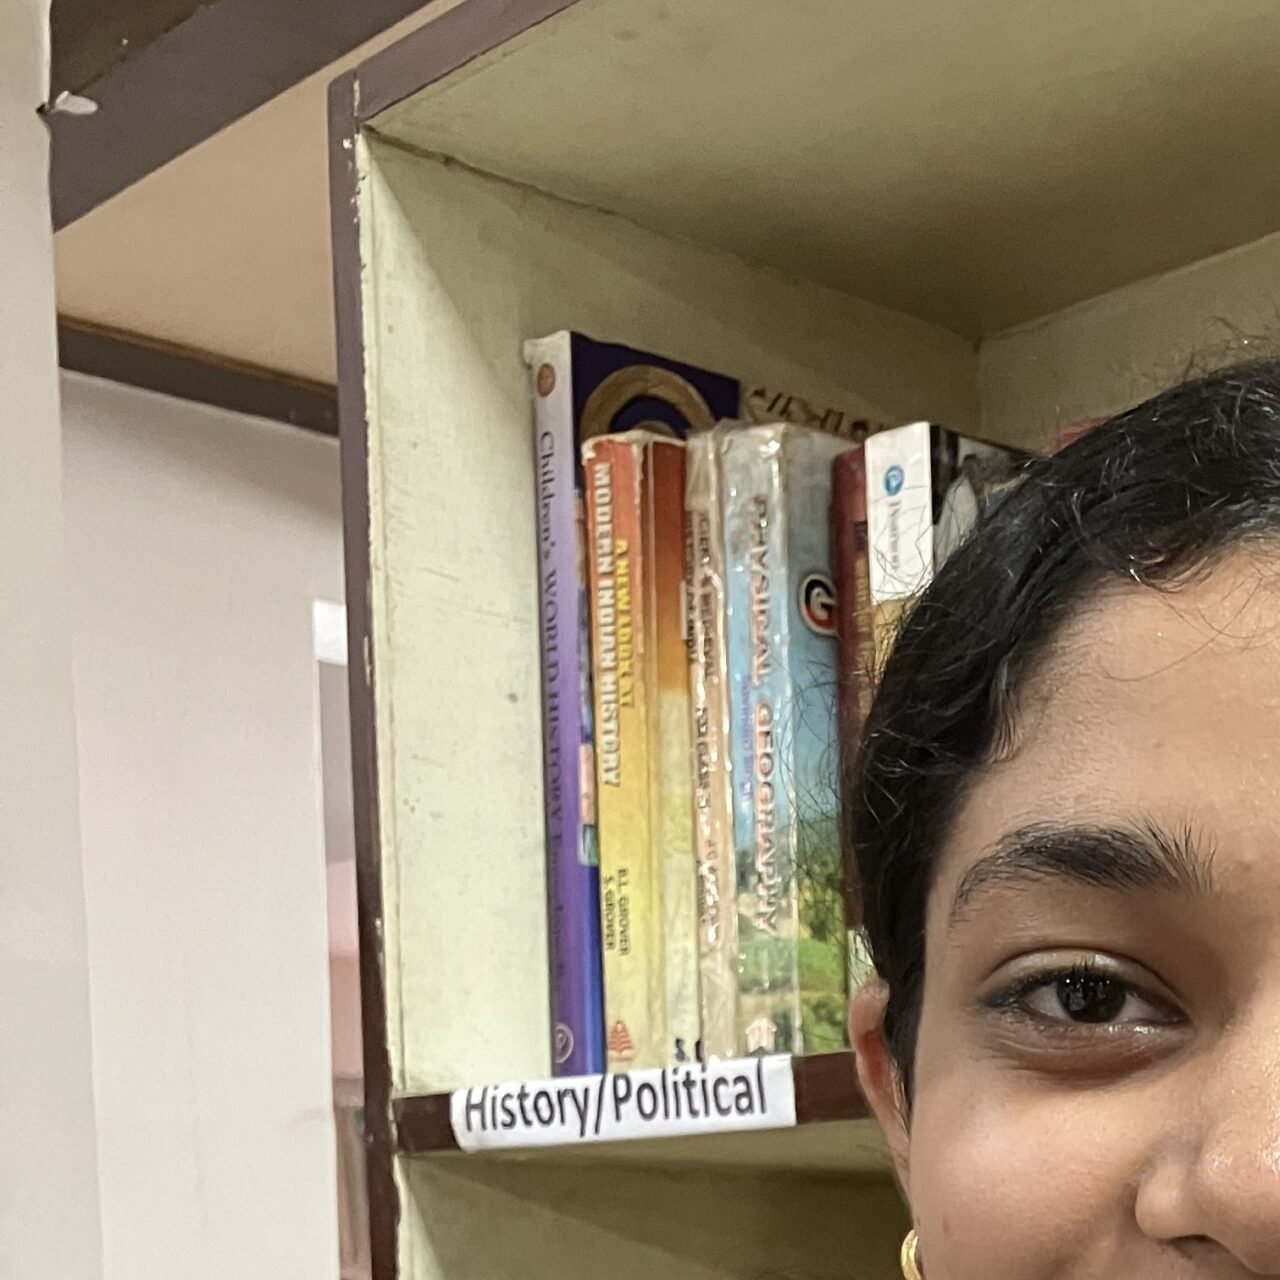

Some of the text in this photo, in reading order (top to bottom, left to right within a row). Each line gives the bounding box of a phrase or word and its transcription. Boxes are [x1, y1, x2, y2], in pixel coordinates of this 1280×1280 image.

[540, 430, 556, 560] Children's
[545, 569, 560, 684] WORLD
[593, 462, 621, 788] MODERN INDIAN HISTORY
[549, 691, 565, 820] HISTORY
[752, 497, 780, 937] PHYSICAL GEOGRAPHY
[605, 890, 616, 951] GROVER
[620, 897, 631, 956] GROVER
[463, 1056, 769, 1138] History/Political
